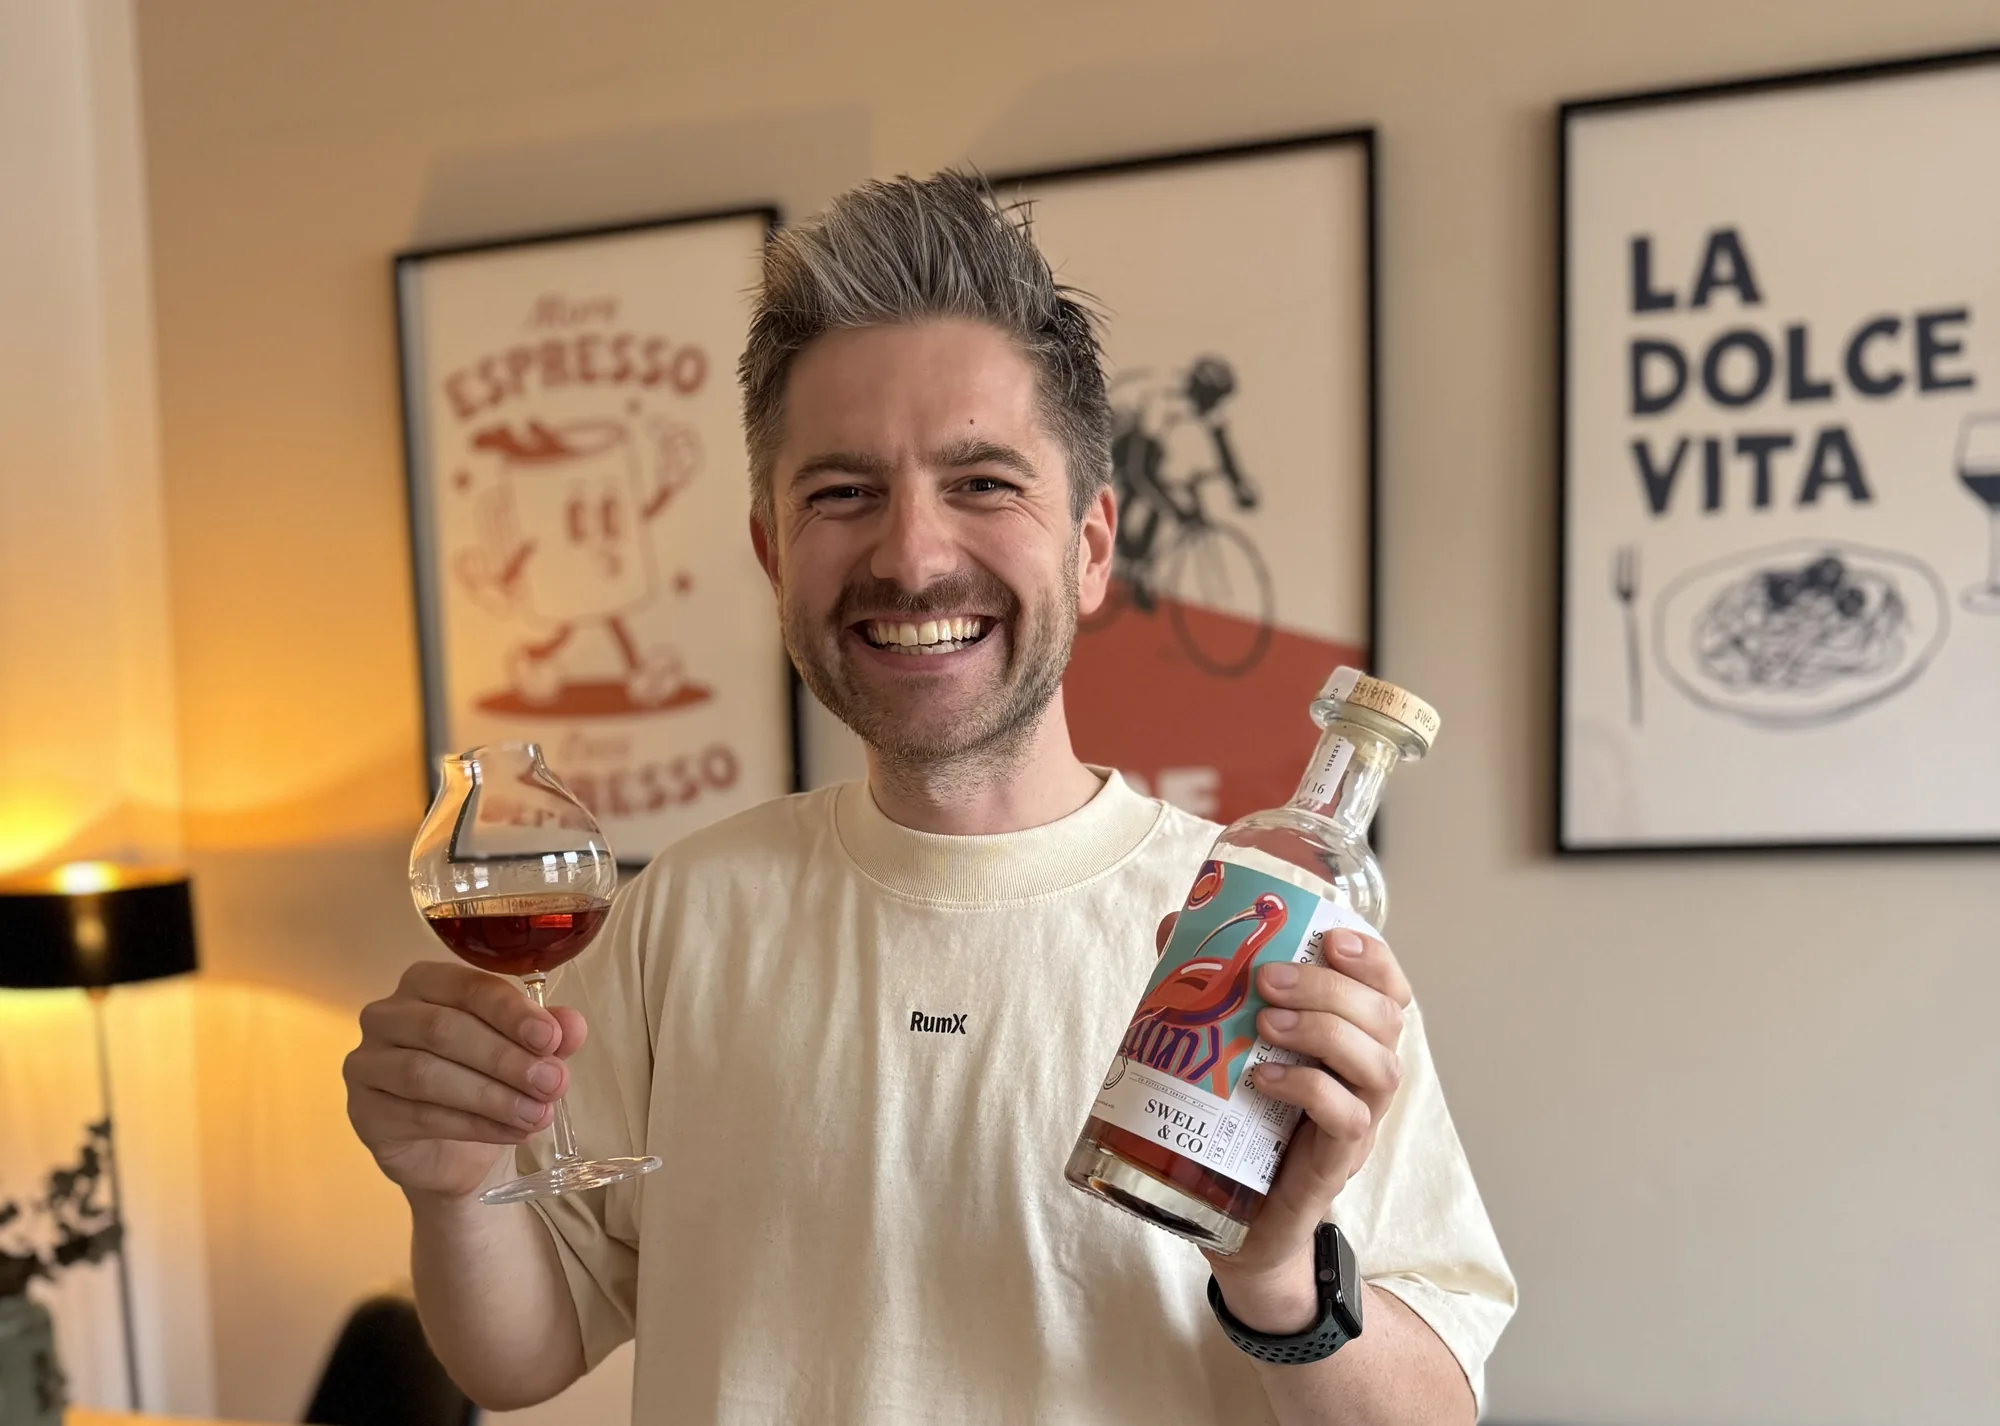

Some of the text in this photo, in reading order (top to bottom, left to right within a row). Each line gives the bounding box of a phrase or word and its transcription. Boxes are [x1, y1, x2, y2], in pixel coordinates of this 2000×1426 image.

[1629, 227, 1765, 315] LA
[445, 335, 708, 421] ESPRESSO
[1629, 306, 1977, 418] DOLCE
[1630, 425, 1873, 517] VITA
[1300, 930, 1324, 964] RITS
[909, 1010, 969, 1035] RumX
[1144, 1098, 1209, 1139] SWELL
[1157, 1124, 1203, 1154] & CO
